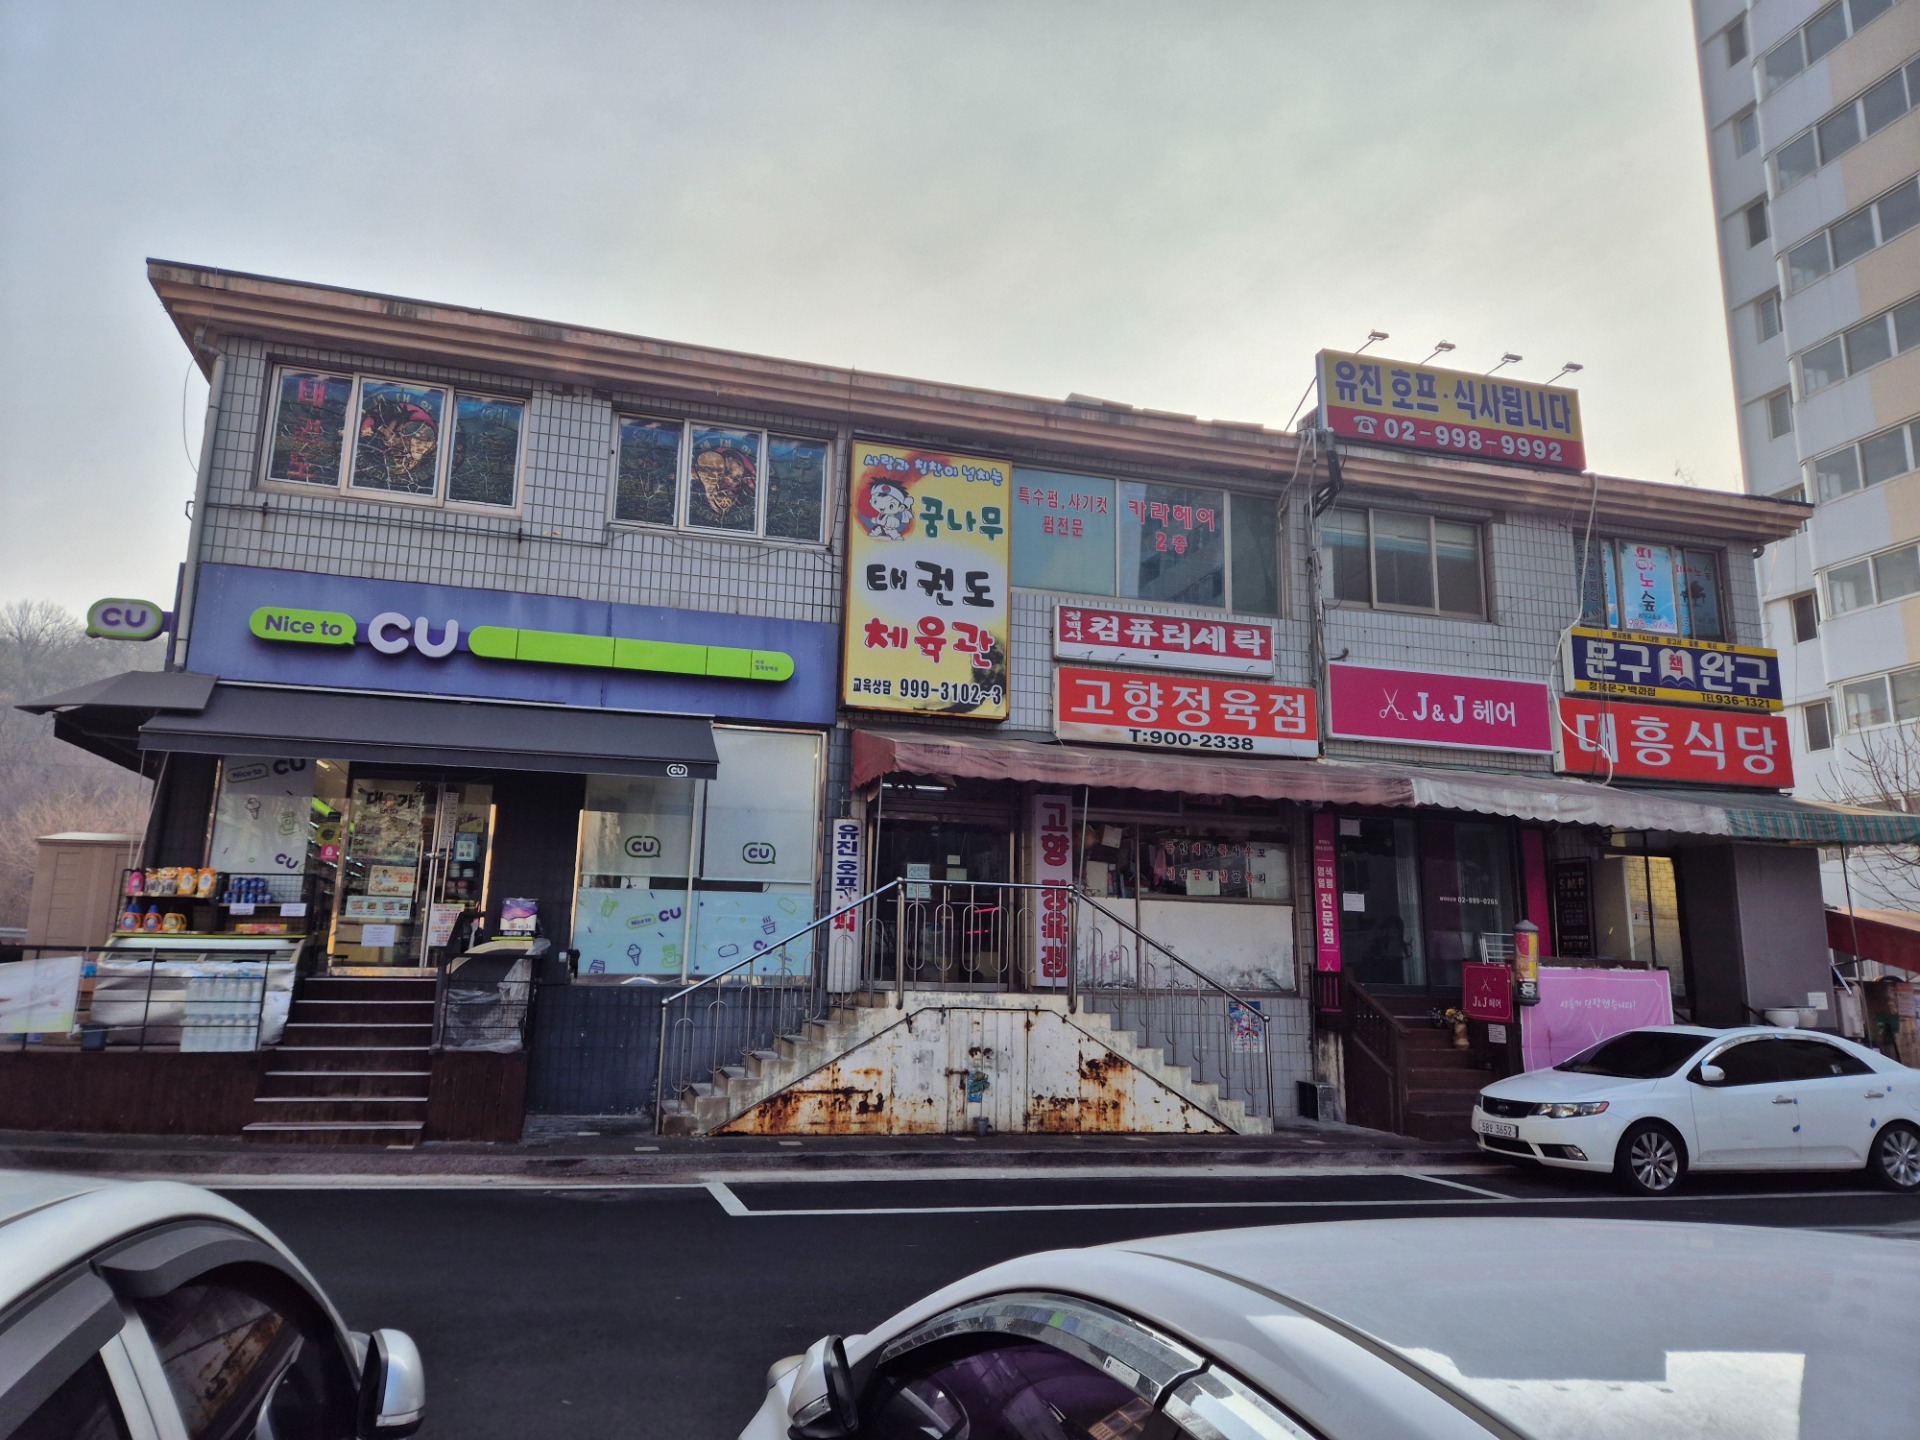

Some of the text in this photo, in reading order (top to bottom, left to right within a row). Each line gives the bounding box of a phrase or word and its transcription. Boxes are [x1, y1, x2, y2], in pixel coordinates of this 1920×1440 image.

[1335, 360, 1383, 406] 유진
[1384, 417, 1563, 462] 02-998-9992
[863, 453, 1004, 487] 사랑과 칭찬이 넘치는
[1043, 515, 1085, 538] 펌전문
[1128, 499, 1215, 532] 카라헤어
[1155, 532, 1188, 554] 2층
[866, 560, 995, 608] 태권도
[101, 607, 147, 627] CU
[264, 611, 460, 658] Nice to CU
[864, 615, 994, 668] 체육관
[1088, 615, 1267, 657] 컴퓨터세탁
[1585, 639, 1770, 695] 문구 책 완구
[852, 677, 892, 696] 교육상담
[1071, 679, 1307, 733] 고향정육점
[1412, 691, 1517, 728] J&J 헤어
[1128, 728, 1254, 751] T:900-2338
[1575, 713, 1778, 774] 대흥식당
[273, 758, 307, 775] CU
[669, 766, 685, 775] CU
[631, 841, 655, 853] CU
[748, 848, 770, 859] CU
[836, 824, 860, 856] 유진
[275, 853, 299, 870] CU
[1040, 802, 1069, 978] 고향 정육점
[658, 906, 682, 922] CU
[1320, 893, 1335, 945] 전문점
